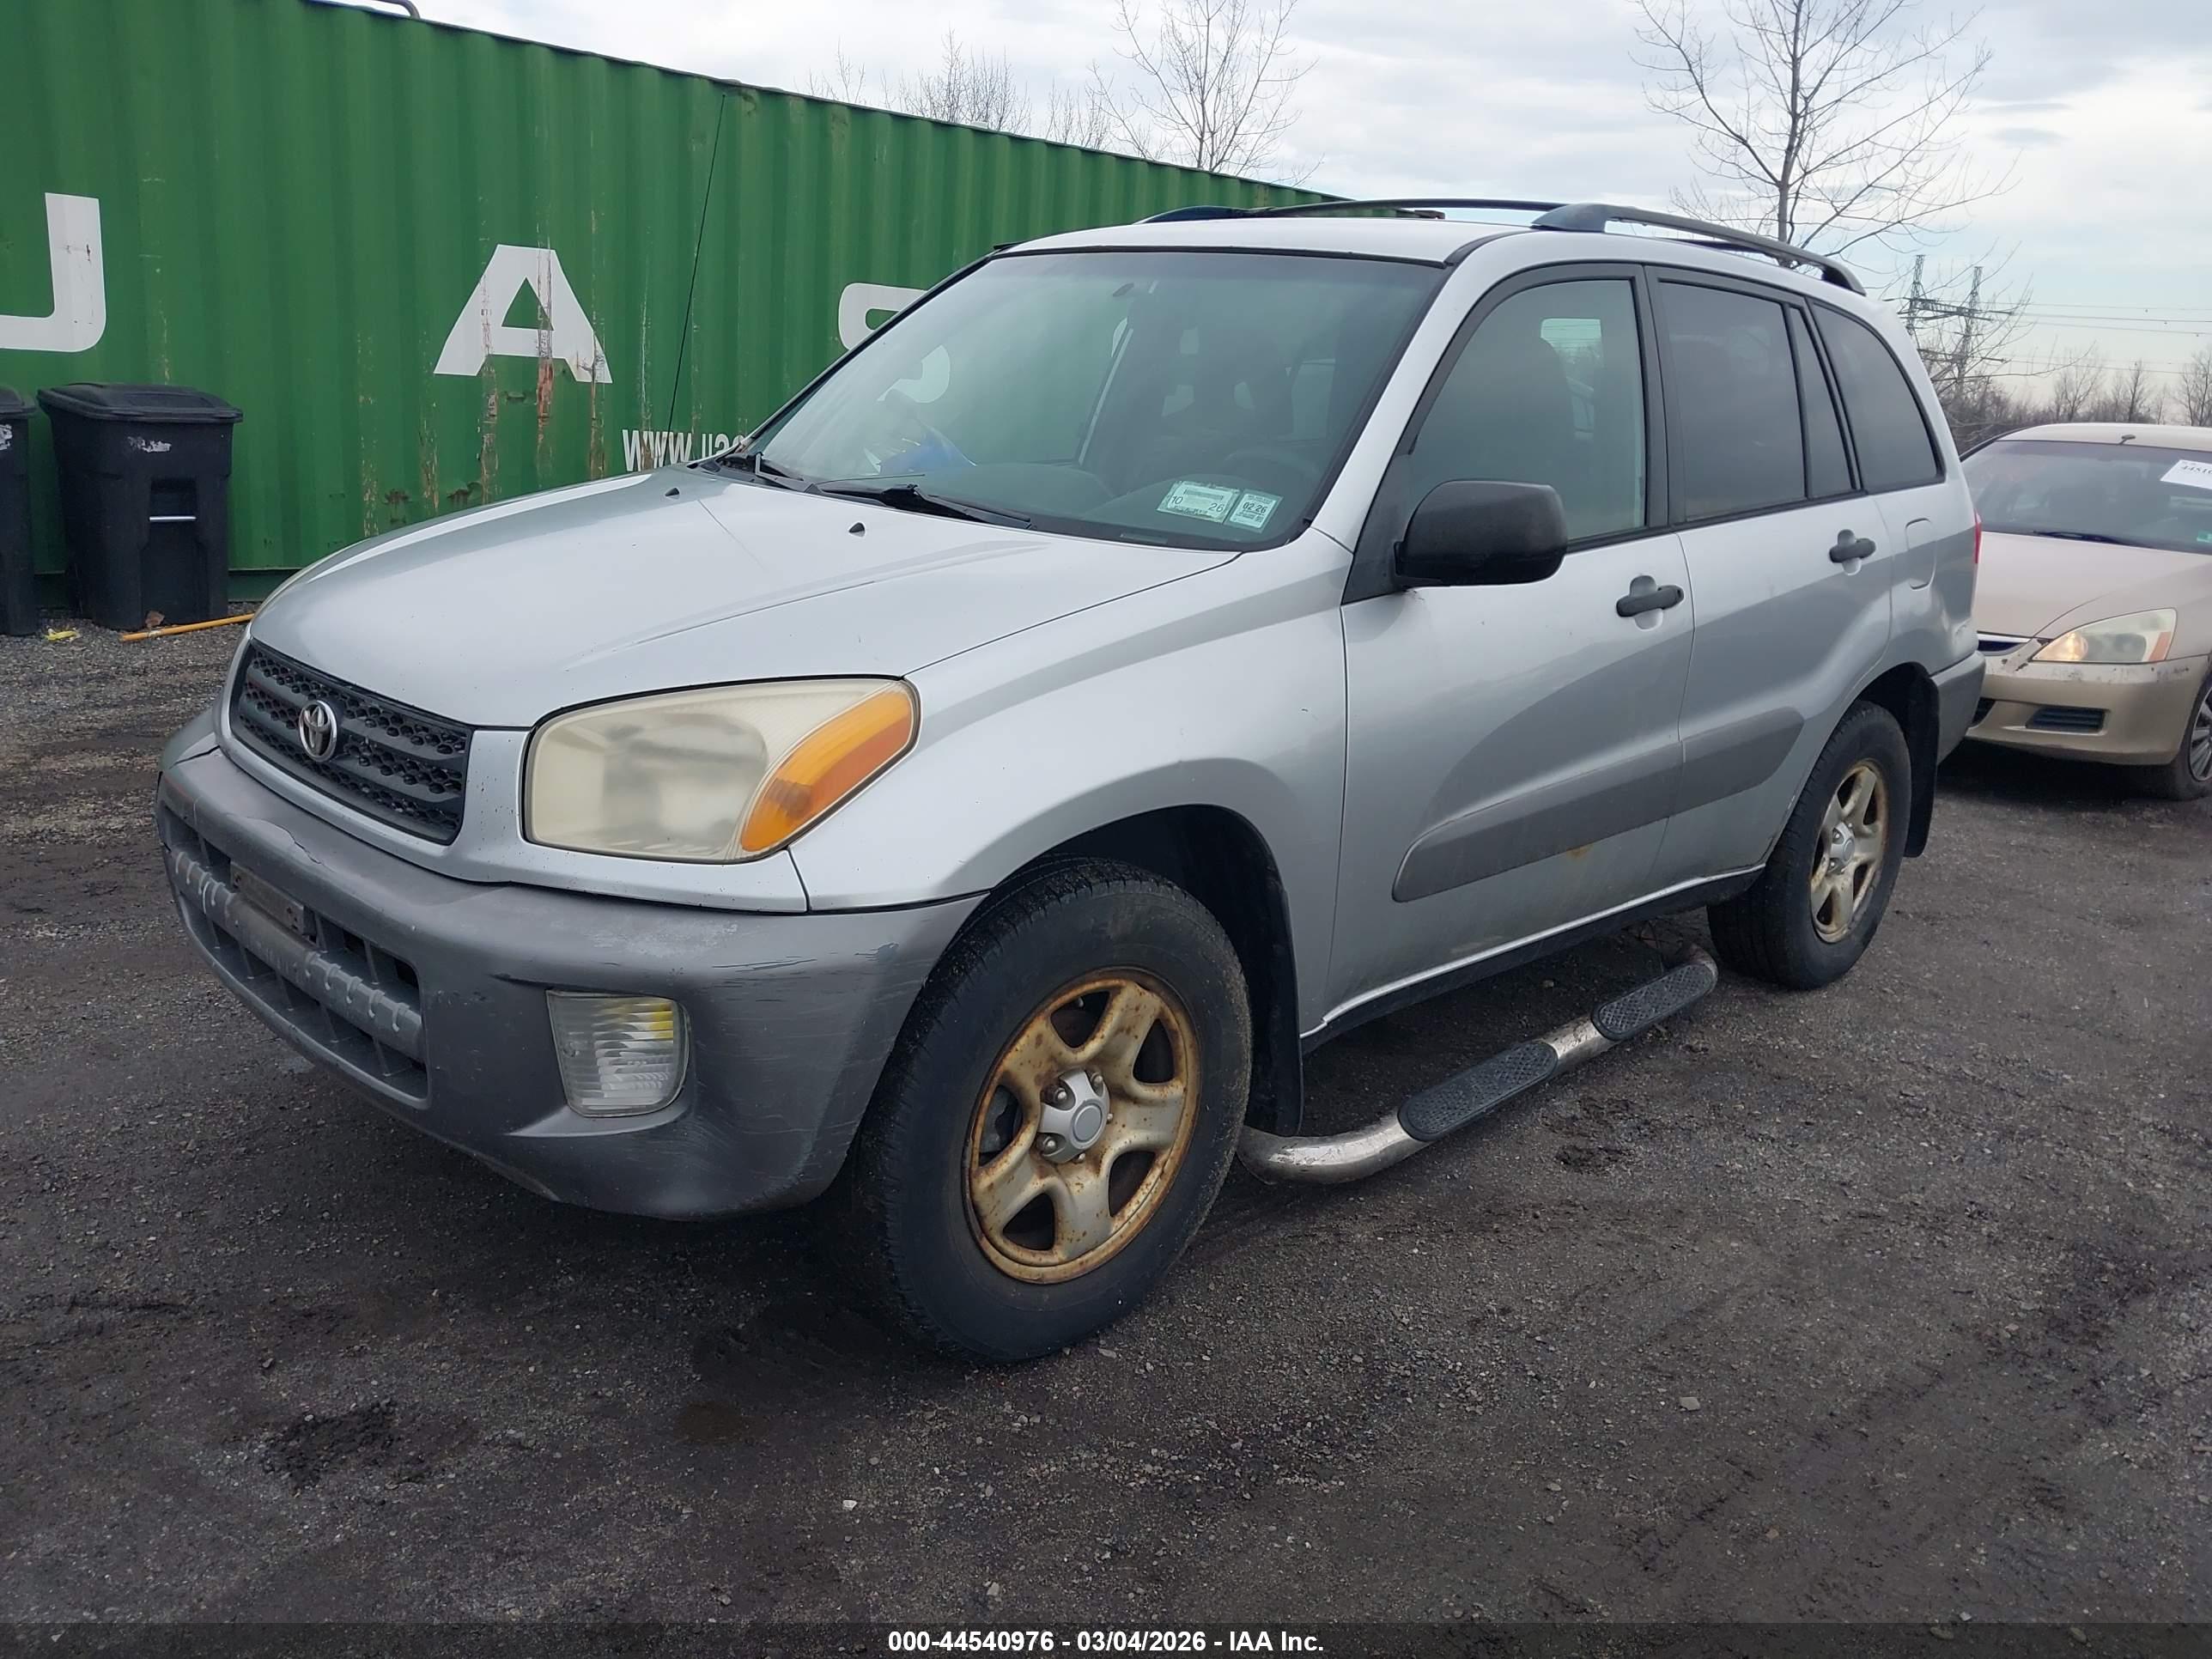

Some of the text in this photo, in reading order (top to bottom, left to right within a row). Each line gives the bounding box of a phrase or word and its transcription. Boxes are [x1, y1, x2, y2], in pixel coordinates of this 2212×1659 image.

[433, 244, 613, 384] A
[1171, 495, 1184, 505] 10
[1207, 502, 1225, 513] 26
[1243, 501, 1268, 514] 02 26
